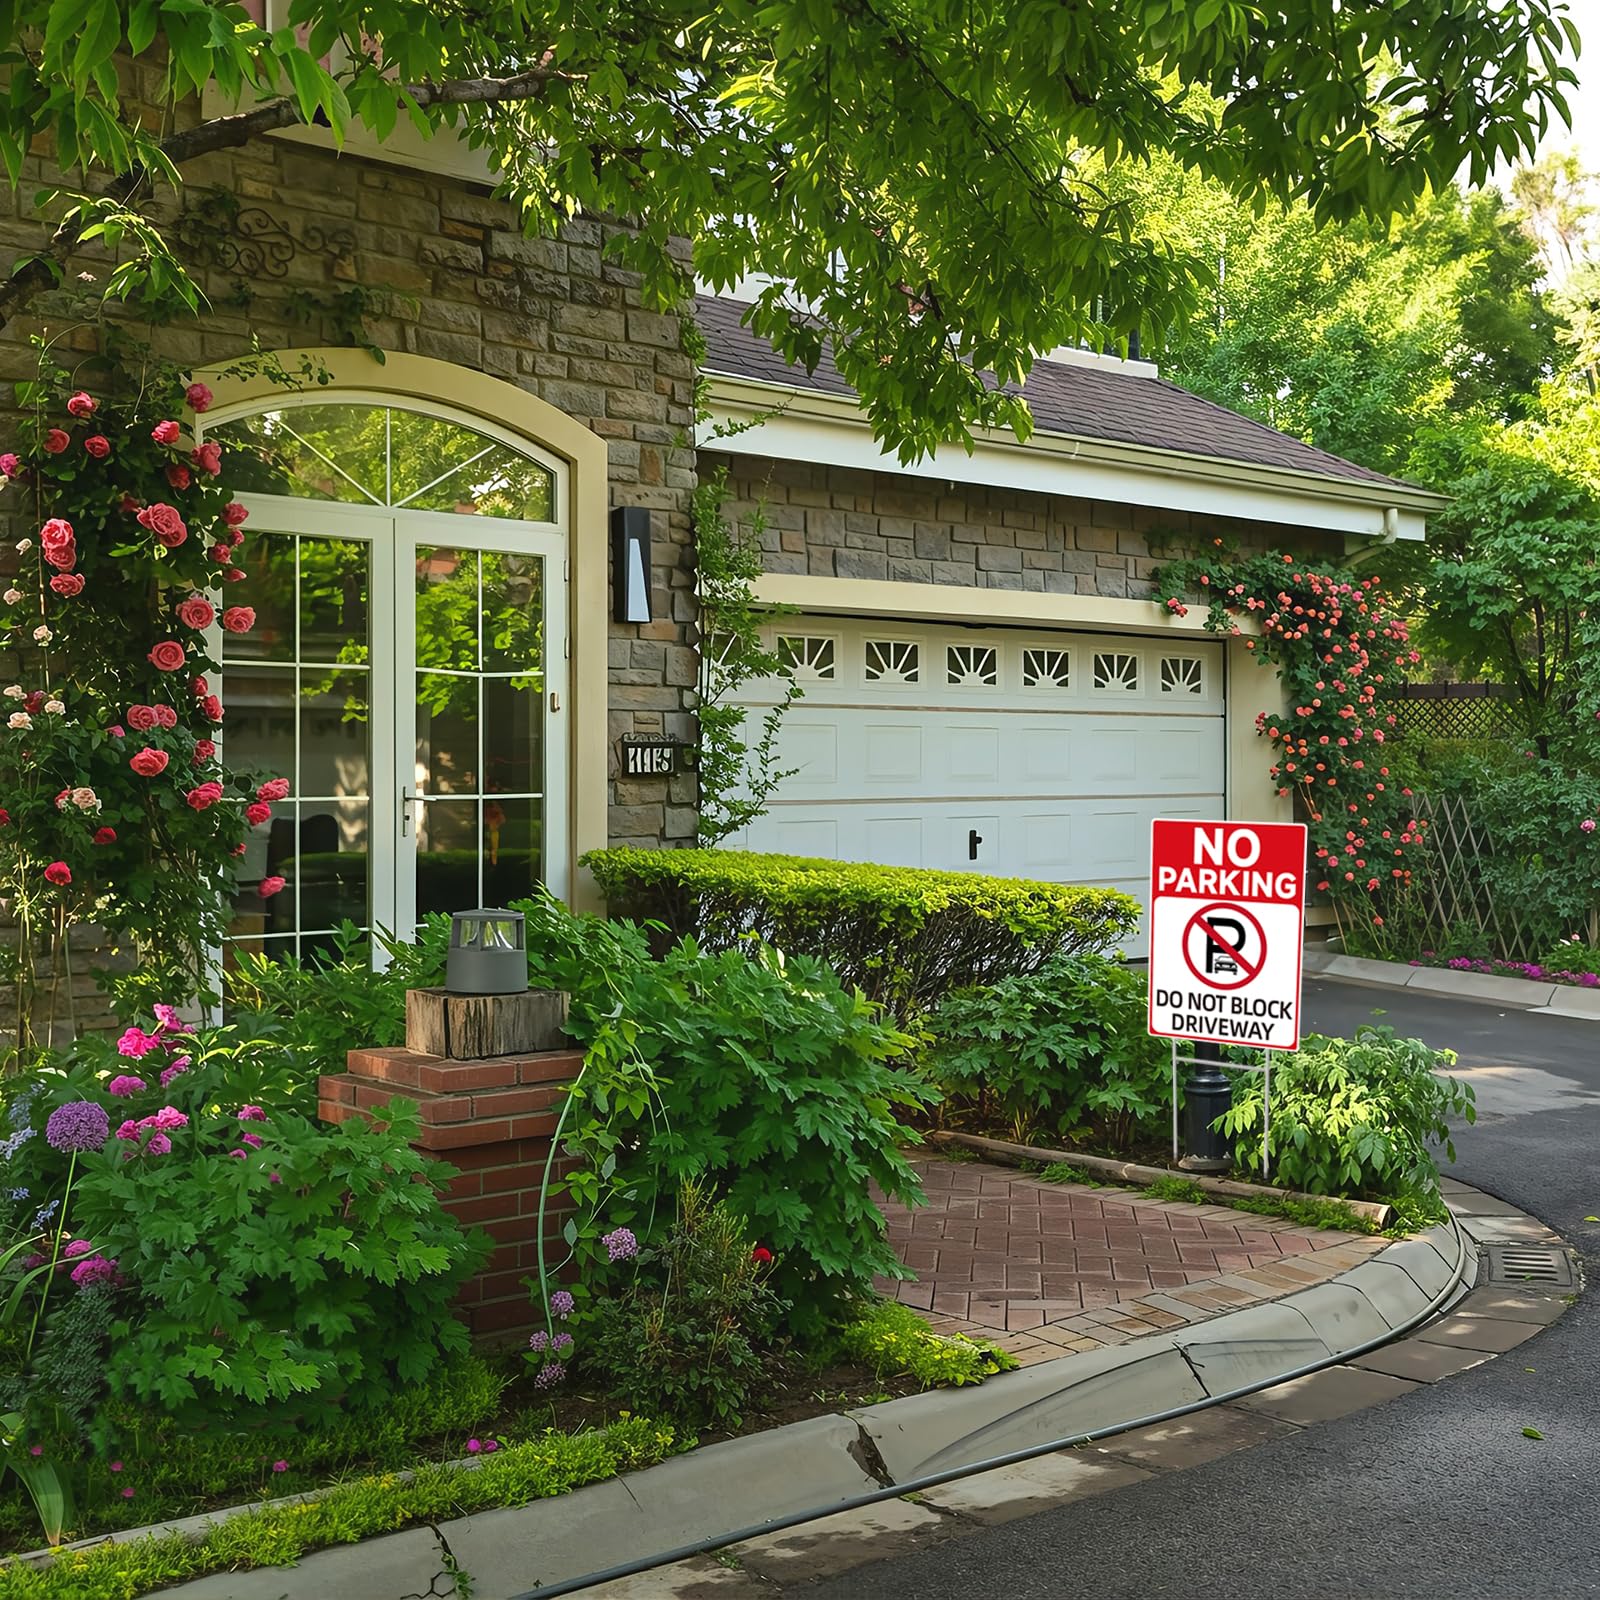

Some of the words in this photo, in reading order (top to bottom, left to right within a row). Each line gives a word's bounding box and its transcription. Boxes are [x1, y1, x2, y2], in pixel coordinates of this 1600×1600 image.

[1194, 827, 1261, 867] NO
[1158, 866, 1297, 899] PARKING
[1156, 989, 1183, 1009] DO
[1188, 992, 1227, 1013] NOT
[1231, 996, 1293, 1020] BLOCK
[1172, 1014, 1275, 1041] DRIVEWAY
